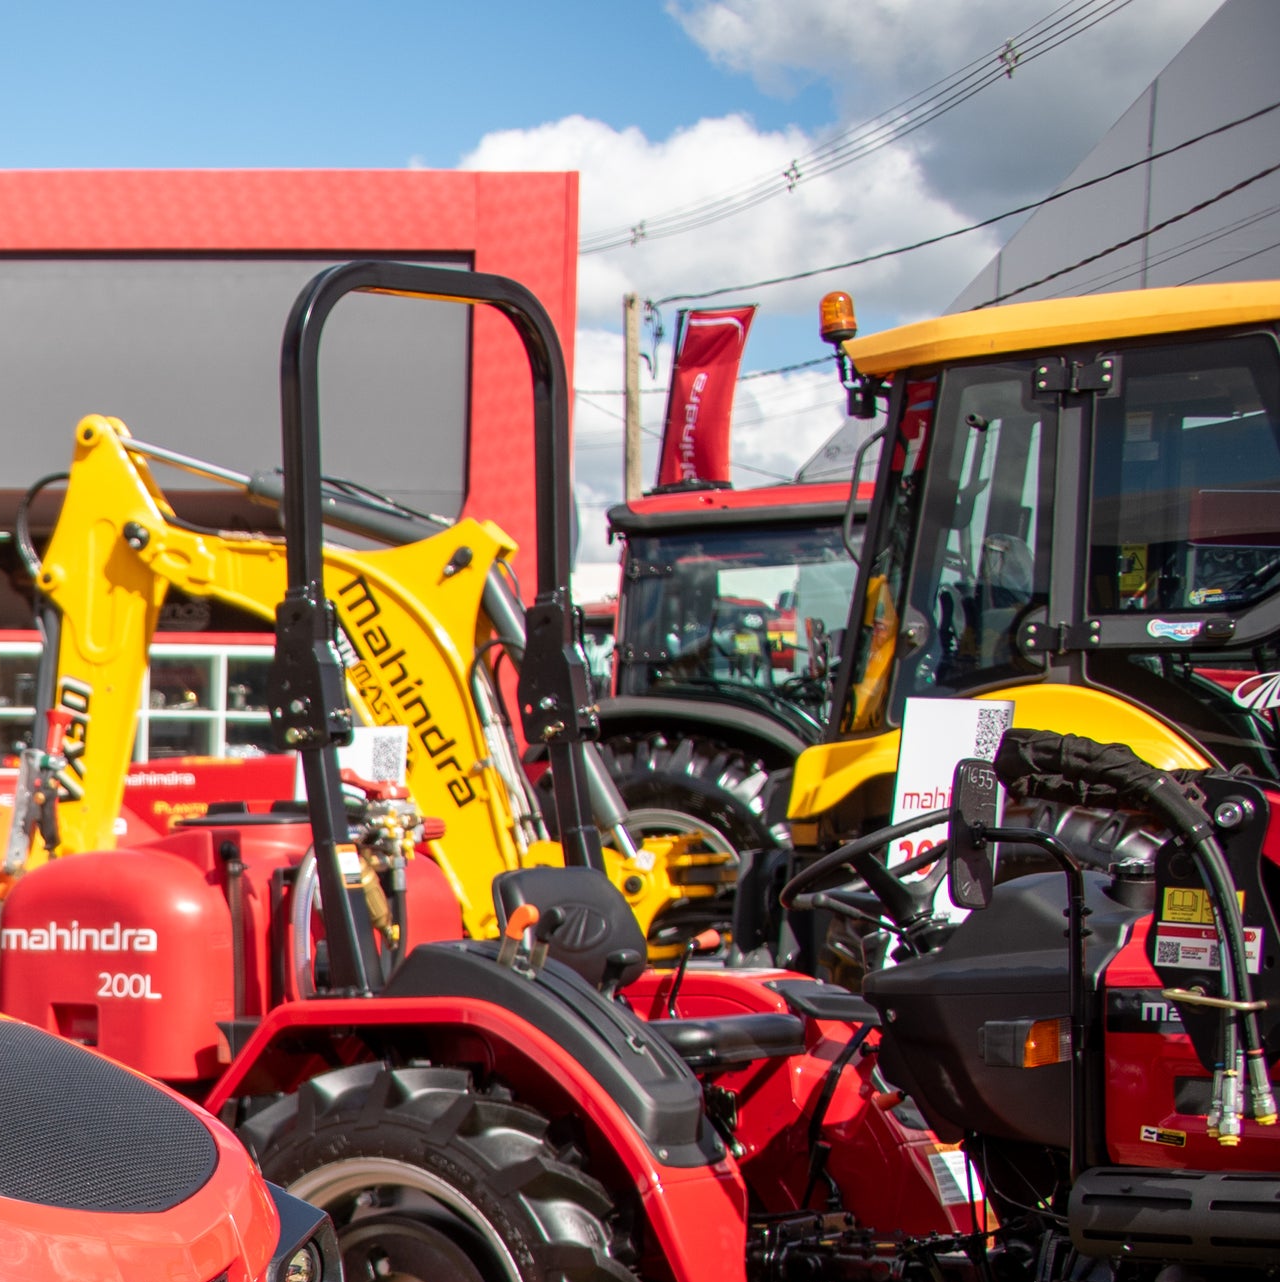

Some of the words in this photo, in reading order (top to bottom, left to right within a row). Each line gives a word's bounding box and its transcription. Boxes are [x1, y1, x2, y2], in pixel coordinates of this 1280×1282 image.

[338, 574, 477, 808] mahindra
[902, 787, 952, 809] mahi
[1, 920, 158, 951] mahindra
[97, 972, 162, 999] 200L
